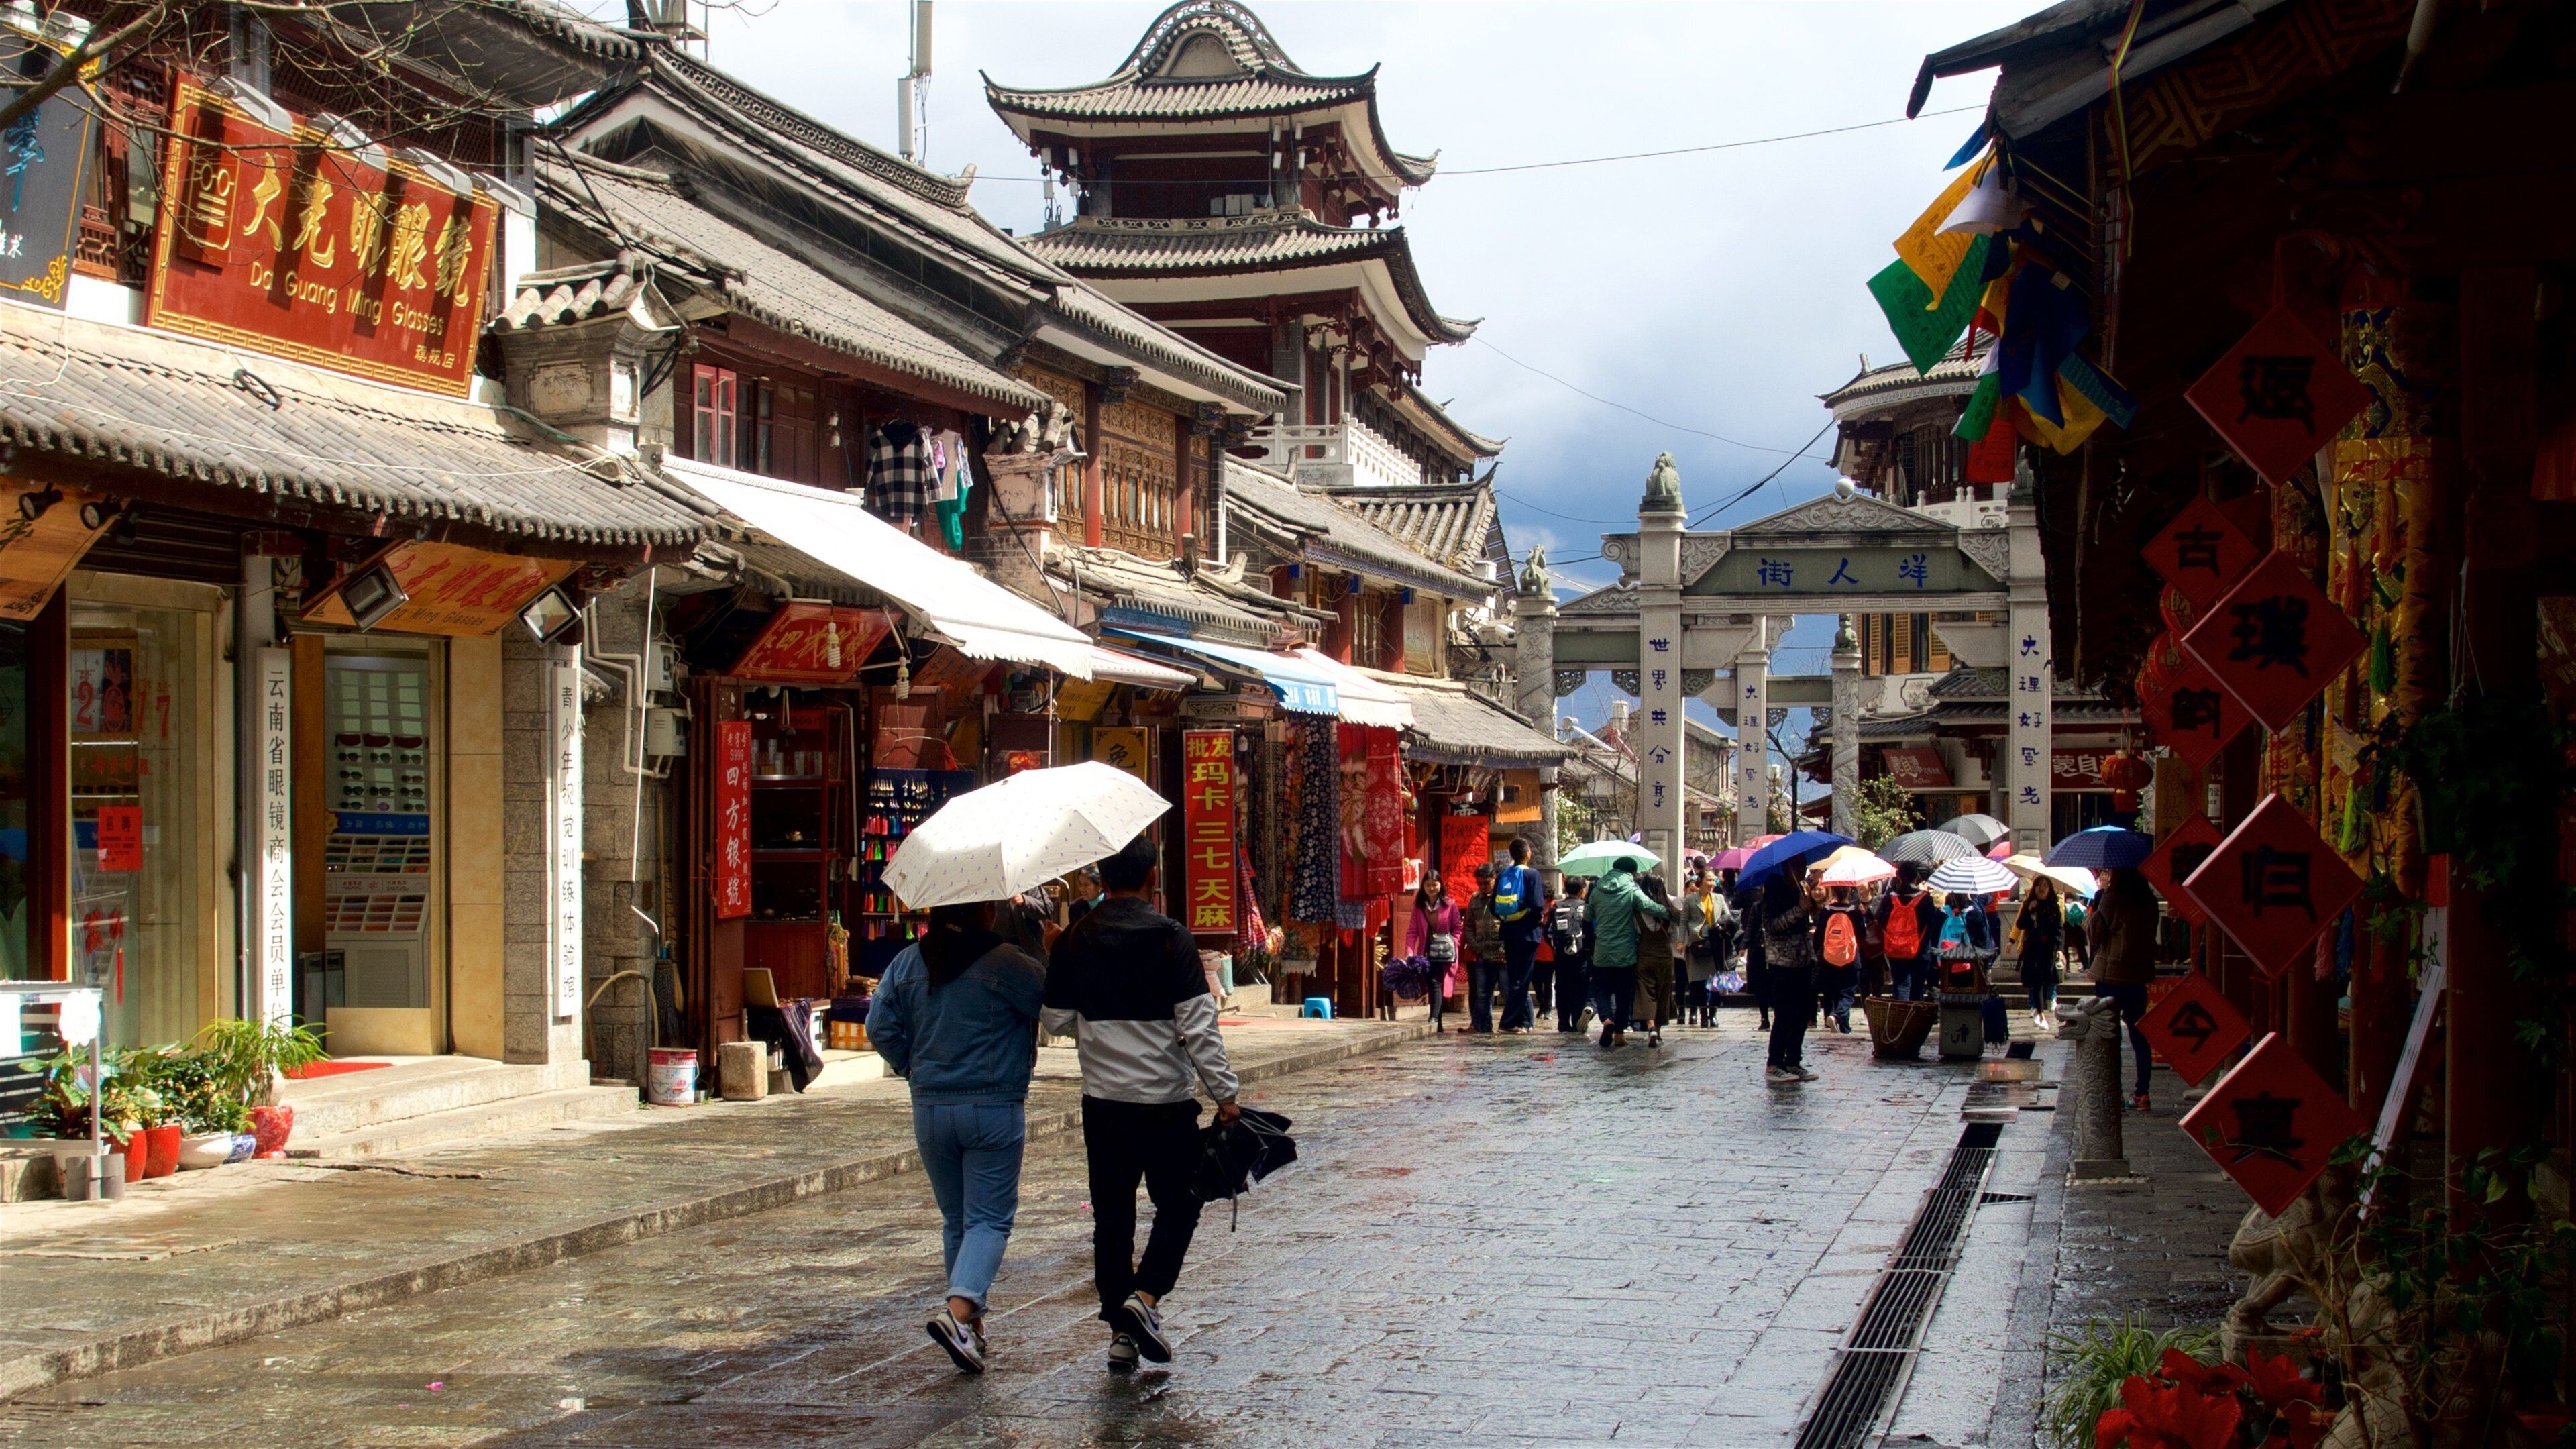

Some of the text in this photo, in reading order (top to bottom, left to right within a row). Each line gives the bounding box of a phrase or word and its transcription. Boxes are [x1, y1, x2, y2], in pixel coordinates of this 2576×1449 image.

[250, 261, 444, 336] Da Guang Ming Glasses
[414, 344, 455, 368] 旗舰店
[411, 608, 440, 623] Ming
[443, 611, 486, 627] Glasses
[1187, 737, 1232, 758] 批发
[1648, 638, 1671, 808] 世界共分享
[729, 749, 745, 761] S999
[268, 670, 285, 1033] 云南省眼镜商会会员单位
[561, 686, 576, 998] 青少年视觉训练体验馆
